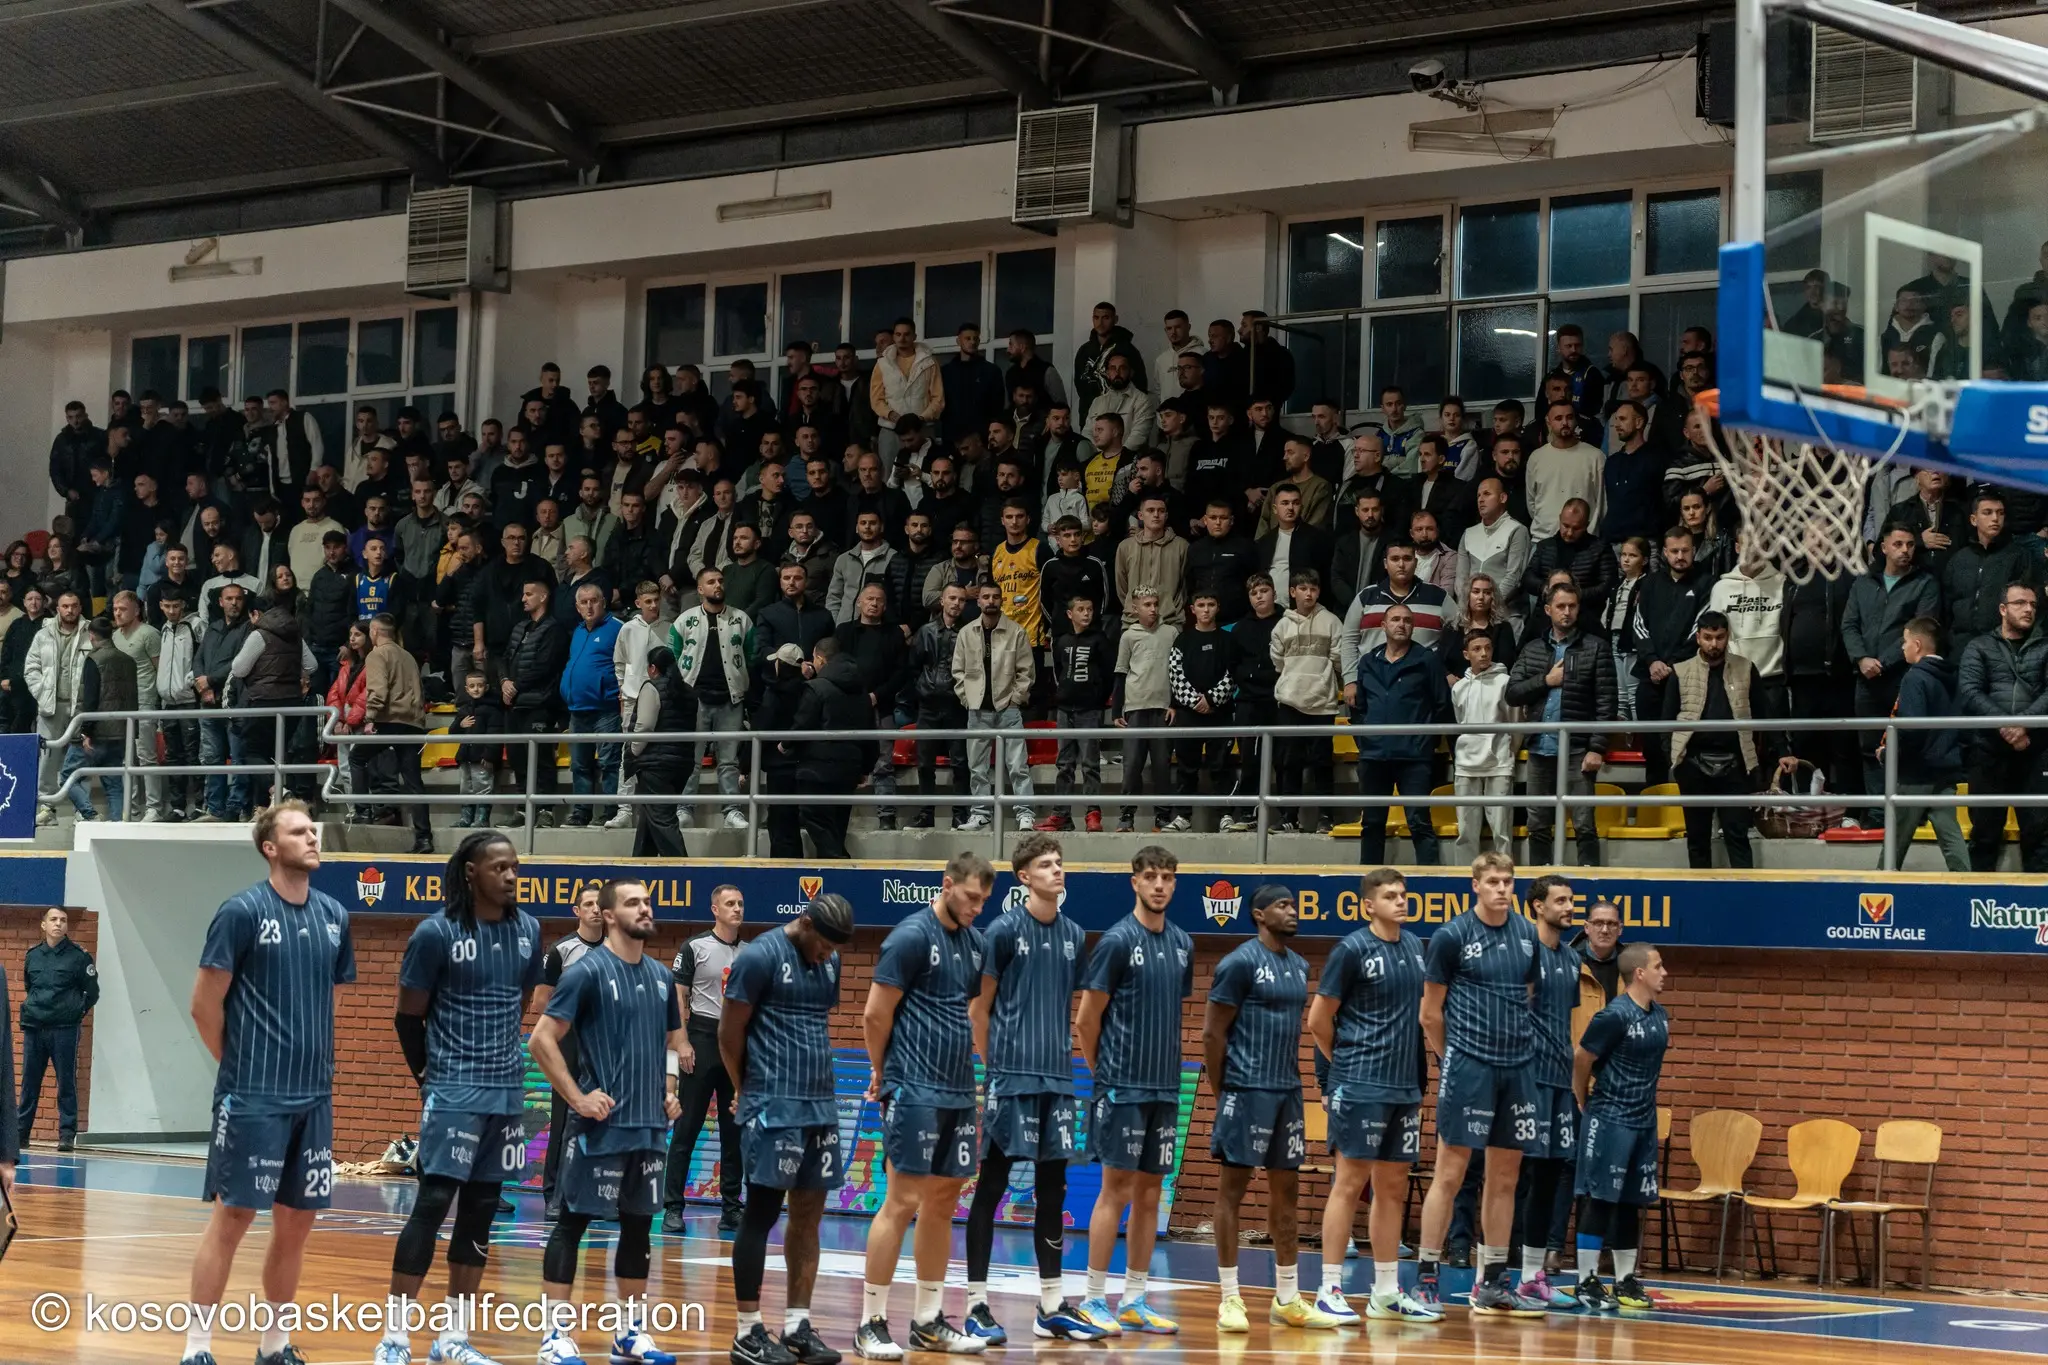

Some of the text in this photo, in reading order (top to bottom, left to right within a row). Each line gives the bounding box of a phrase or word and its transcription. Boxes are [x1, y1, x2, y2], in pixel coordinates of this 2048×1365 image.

[1004, 582, 1017, 593] YLLI
[1074, 646, 1090, 682] UNLTD
[362, 884, 380, 897] YLLI
[406, 875, 446, 901] K.B.
[1210, 901, 1234, 915] YLLI
[259, 918, 282, 945] 23
[1827, 926, 1926, 941] GOLDEN EAGLE
[452, 938, 477, 964] 00
[930, 944, 940, 966] 6
[1463, 941, 1482, 960] 33
[782, 963, 792, 984] 2
[1364, 956, 1385, 979] 27
[608, 979, 619, 1001] 1
[1627, 1022, 1645, 1039] 44
[1515, 1118, 1537, 1141] 33
[502, 1143, 526, 1171] 00
[957, 1142, 970, 1166] 6
[1158, 1142, 1174, 1166] 16
[1287, 1134, 1305, 1159] 24
[821, 1151, 834, 1178] 2
[304, 1168, 331, 1197] 23
[650, 1177, 658, 1205] 1
[1640, 1176, 1658, 1197] 44
